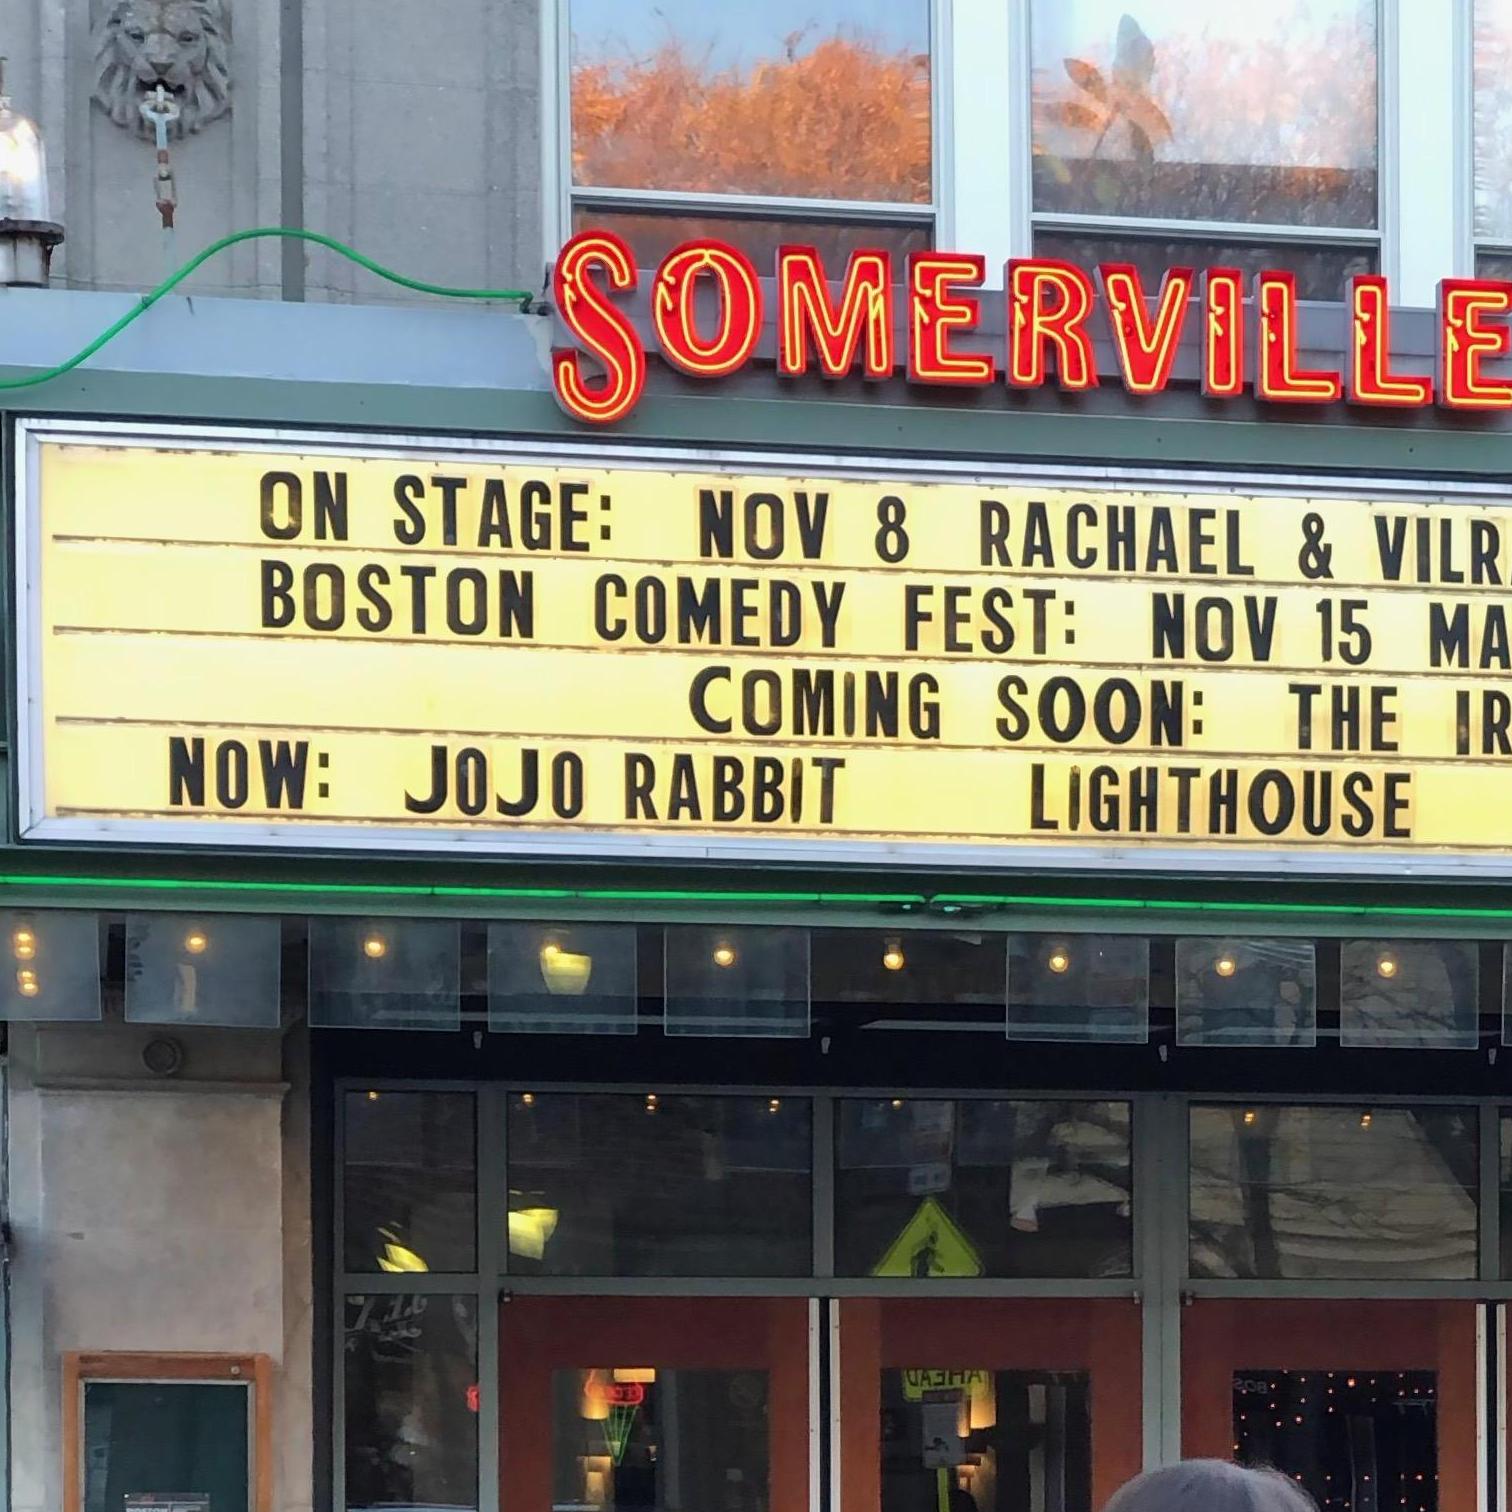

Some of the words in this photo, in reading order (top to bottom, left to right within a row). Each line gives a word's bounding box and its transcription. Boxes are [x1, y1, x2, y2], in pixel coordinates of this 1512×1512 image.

[261, 472, 347, 540] ON
[394, 476, 610, 551] STAGE:
[700, 491, 828, 558] NOV
[876, 497, 908, 562] 8
[981, 501, 1253, 575] RACHAEL
[1299, 513, 1333, 578] &
[262, 560, 532, 638] BOSTON
[596, 574, 845, 647] COMEDY
[906, 586, 1074, 654] FEST:
[1153, 594, 1277, 661] NOV
[1317, 599, 1371, 664] 15
[690, 667, 939, 739] COMING
[998, 676, 1202, 746] SOON:
[1290, 684, 1397, 751] THE
[171, 738, 328, 808] NOW:
[406, 746, 582, 818] JOJO
[626, 754, 844, 823] RABBIT
[1032, 765, 1410, 837] LIGHTHOUSE
